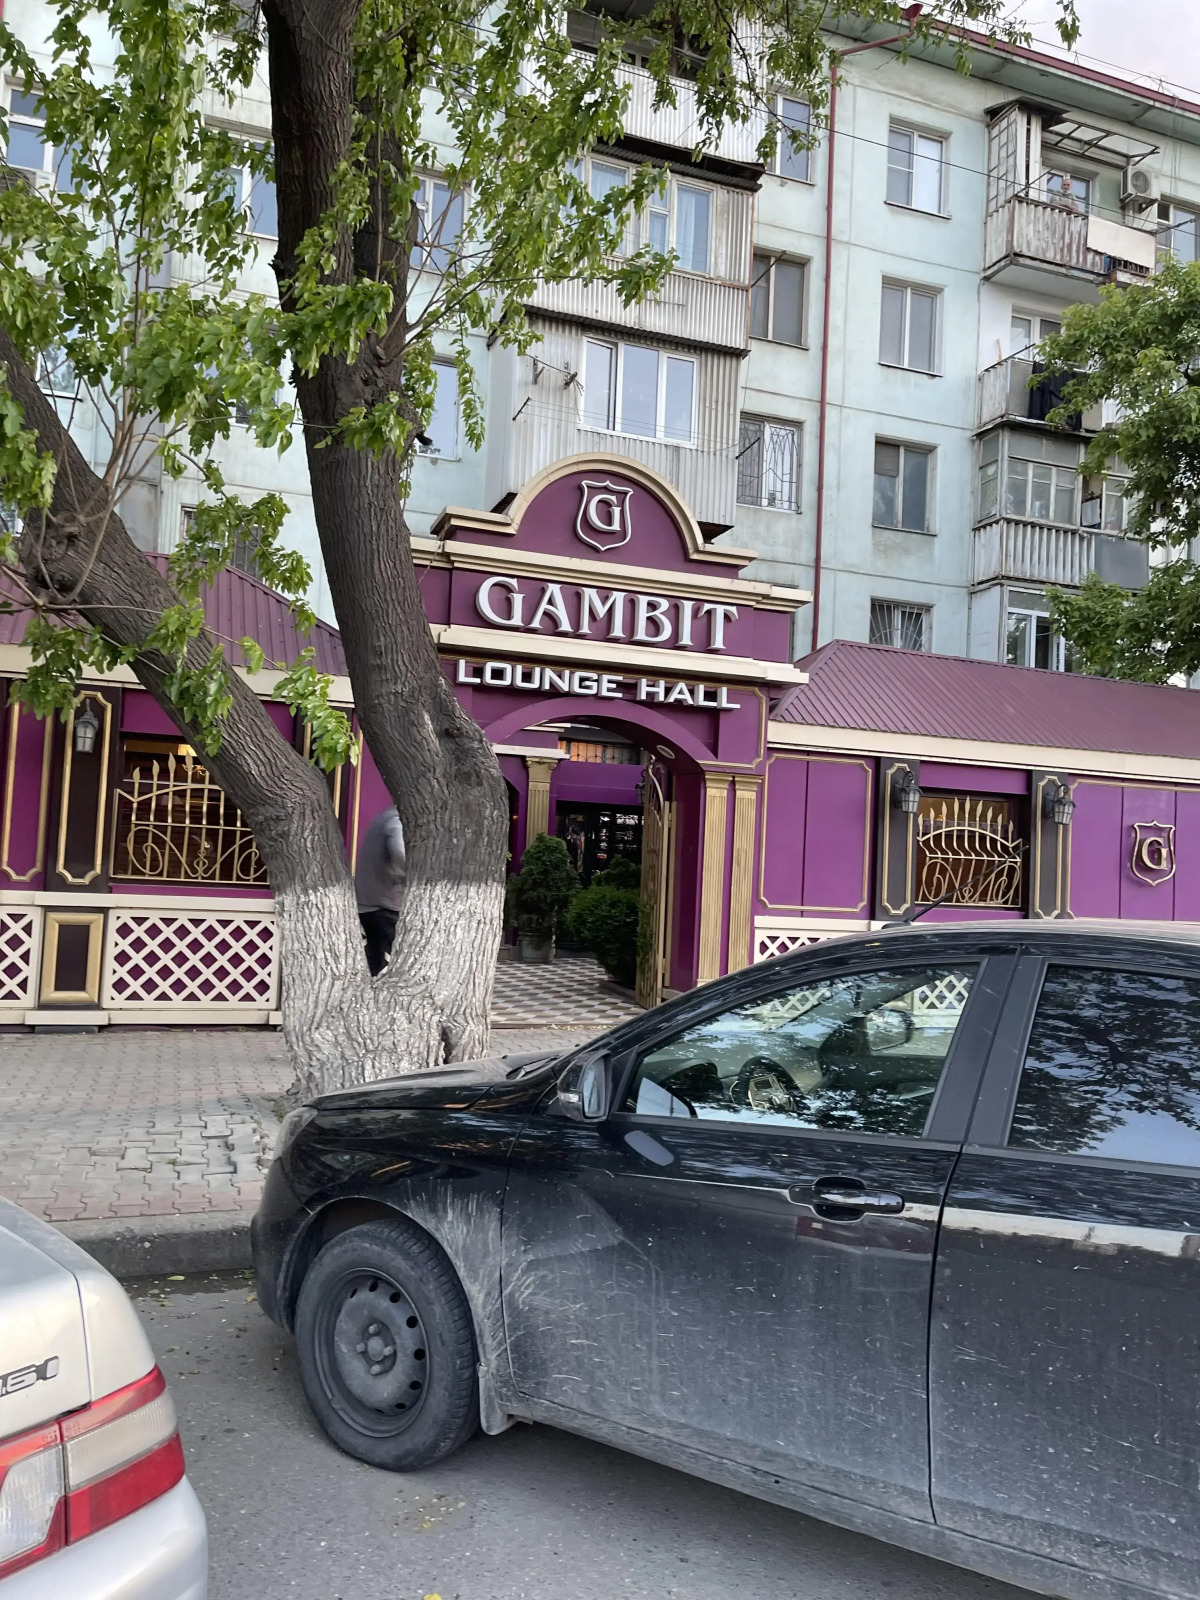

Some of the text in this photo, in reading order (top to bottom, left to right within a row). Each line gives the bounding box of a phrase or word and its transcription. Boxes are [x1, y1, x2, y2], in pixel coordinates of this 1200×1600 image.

[587, 494, 622, 533] G
[475, 576, 739, 651] GAMBIT
[456, 659, 741, 709] LOUNGE HALL
[1141, 836, 1169, 870] G
